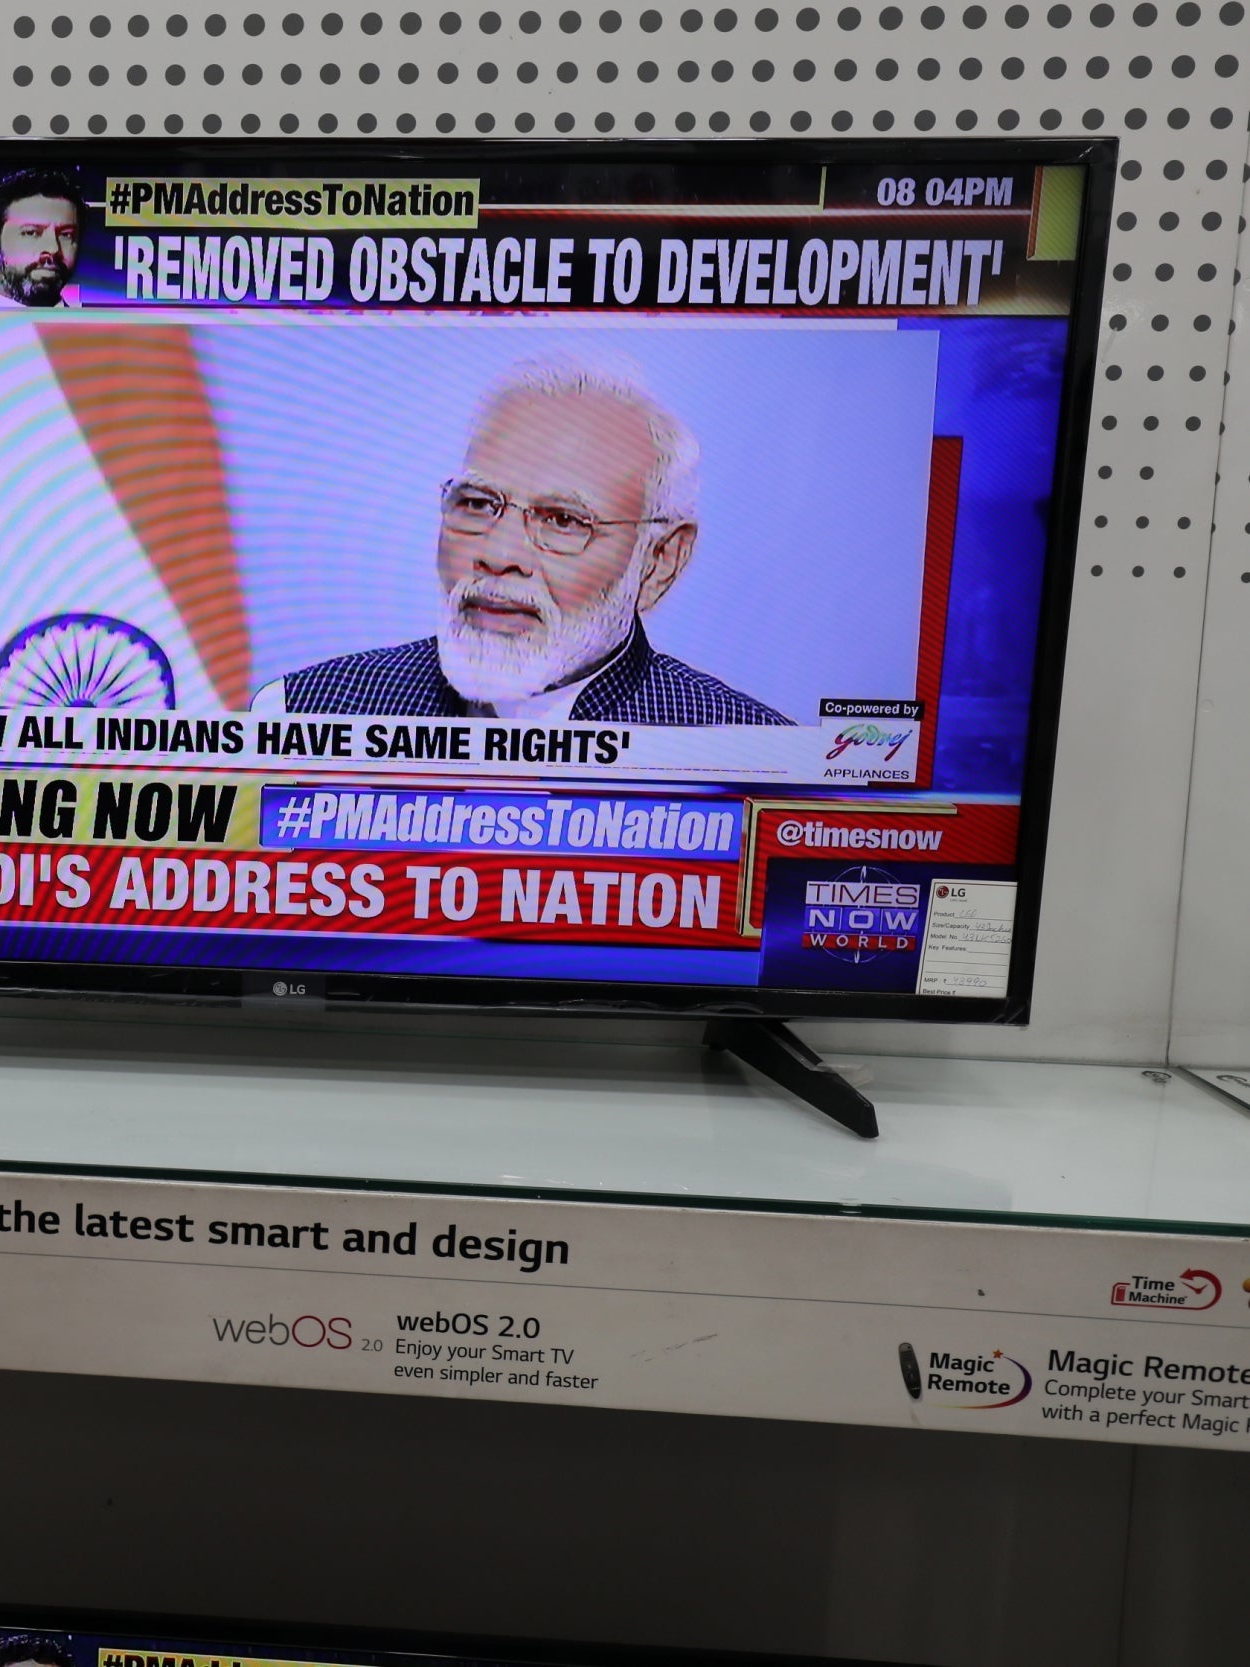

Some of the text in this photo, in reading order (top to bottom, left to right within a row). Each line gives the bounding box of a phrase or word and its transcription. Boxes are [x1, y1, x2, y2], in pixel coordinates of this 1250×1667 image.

[111, 183, 474, 217] #PMAddressToNation
[876, 178, 1013, 207] 08 04PM
[115, 235, 1004, 307] 'REMOVED OBSTACLE TO DEVELOPMENT'
[825, 702, 919, 717] Co-powered by
[17, 716, 84, 749] ALL
[96, 717, 244, 754] INDIANS
[257, 721, 351, 760] HAVE
[365, 724, 471, 760] SAME
[484, 727, 630, 765] RIGHTS'
[824, 769, 910, 780] APPLIANCES
[93, 782, 238, 843] NOW
[277, 791, 735, 852] #PMAddressToNation
[777, 820, 943, 851] @timesnow
[109, 856, 384, 919] ADDRESS
[406, 865, 479, 921] TO
[500, 868, 721, 929] NATION
[809, 883, 918, 905] TIMES
[951, 888, 966, 897] LG
[809, 909, 917, 930] NOW
[932, 922, 970, 930] Size/Capacity
[810, 934, 908, 949] WORLD
[289, 984, 306, 995] LG
[74, 1203, 194, 1242] latest
[208, 1219, 329, 1251] smart
[342, 1222, 417, 1256] and
[432, 1224, 570, 1273] design
[1132, 1275, 1175, 1292] Time
[213, 1313, 383, 1353] webOS 2.0
[397, 1312, 541, 1339] webOS 2.0
[395, 1339, 574, 1365] Enjoy your Smart TV
[930, 1352, 994, 1375] Magic
[1048, 1349, 1134, 1381] Magic
[394, 1363, 599, 1389] even simpler and faster
[928, 1373, 1010, 1395] Remote
[1044, 1379, 1136, 1403] Complete
[1142, 1388, 1186, 1406] your
[1042, 1406, 1083, 1421] with
[1089, 1411, 1100, 1422] a
[1106, 1407, 1176, 1428] perfect
[1182, 1413, 1239, 1436] Magic
